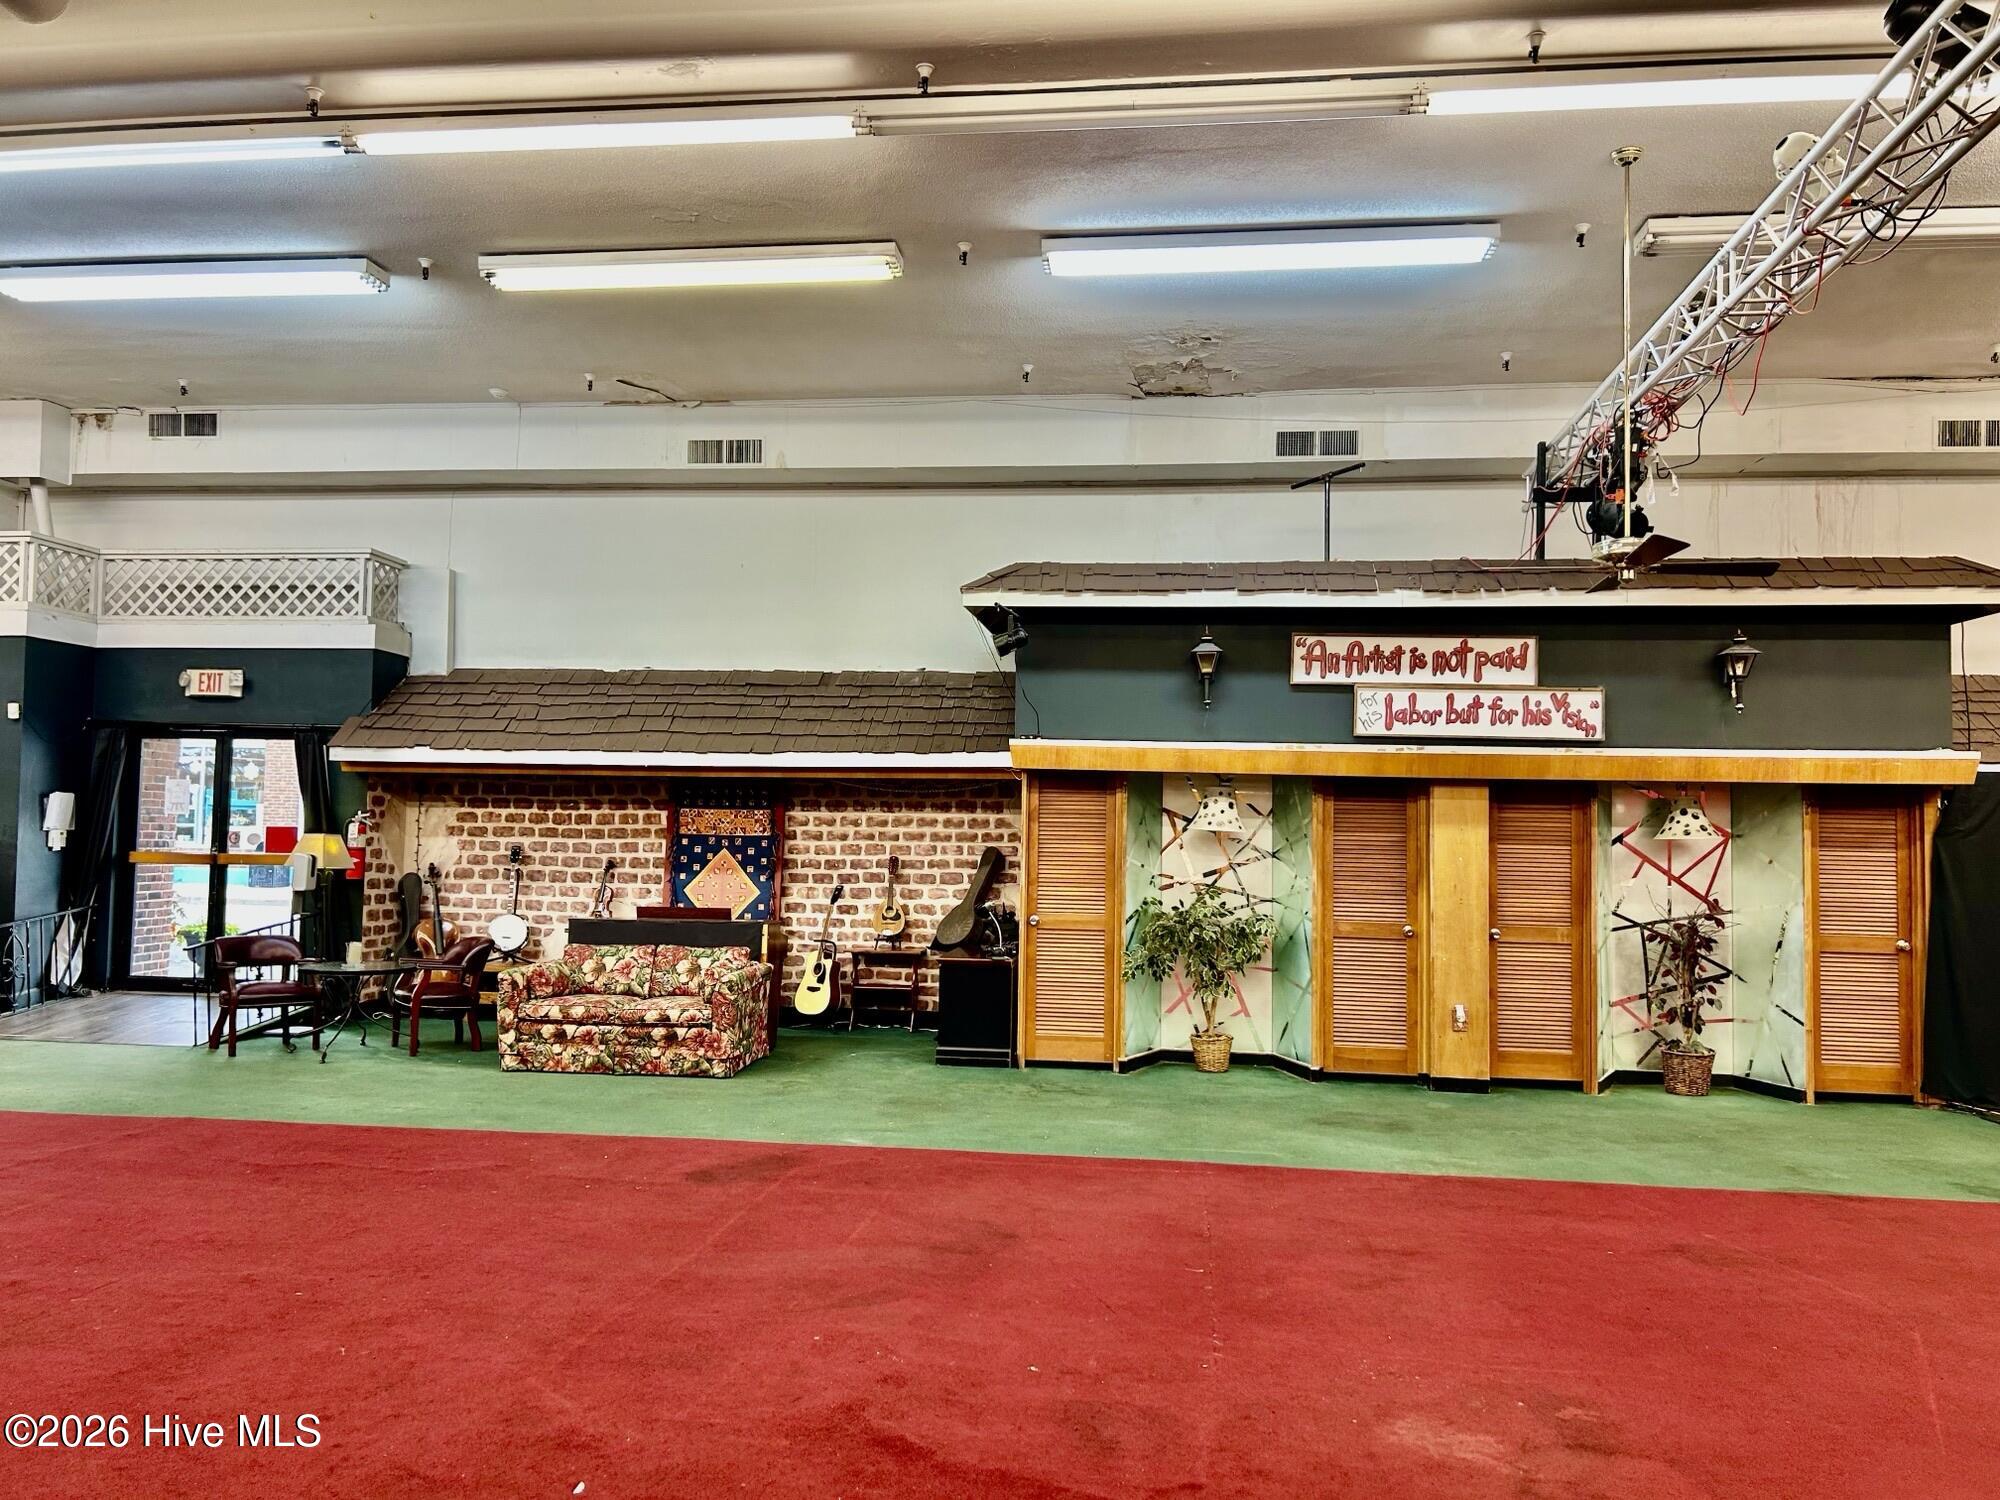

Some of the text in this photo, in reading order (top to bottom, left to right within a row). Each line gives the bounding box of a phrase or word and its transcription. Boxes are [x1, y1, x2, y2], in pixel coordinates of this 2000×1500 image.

[1341, 640, 1405, 678] Artist
[1409, 647, 1428, 675] is
[1432, 638, 1474, 678] not
[1474, 641, 1529, 683] paid
[198, 672, 224, 693] EXIT
[1359, 692, 1378, 710] for
[1384, 692, 1442, 731] labor
[1446, 692, 1485, 725] but
[1488, 696, 1518, 726] for
[1522, 695, 1552, 727] his
[1358, 710, 1383, 732] his
